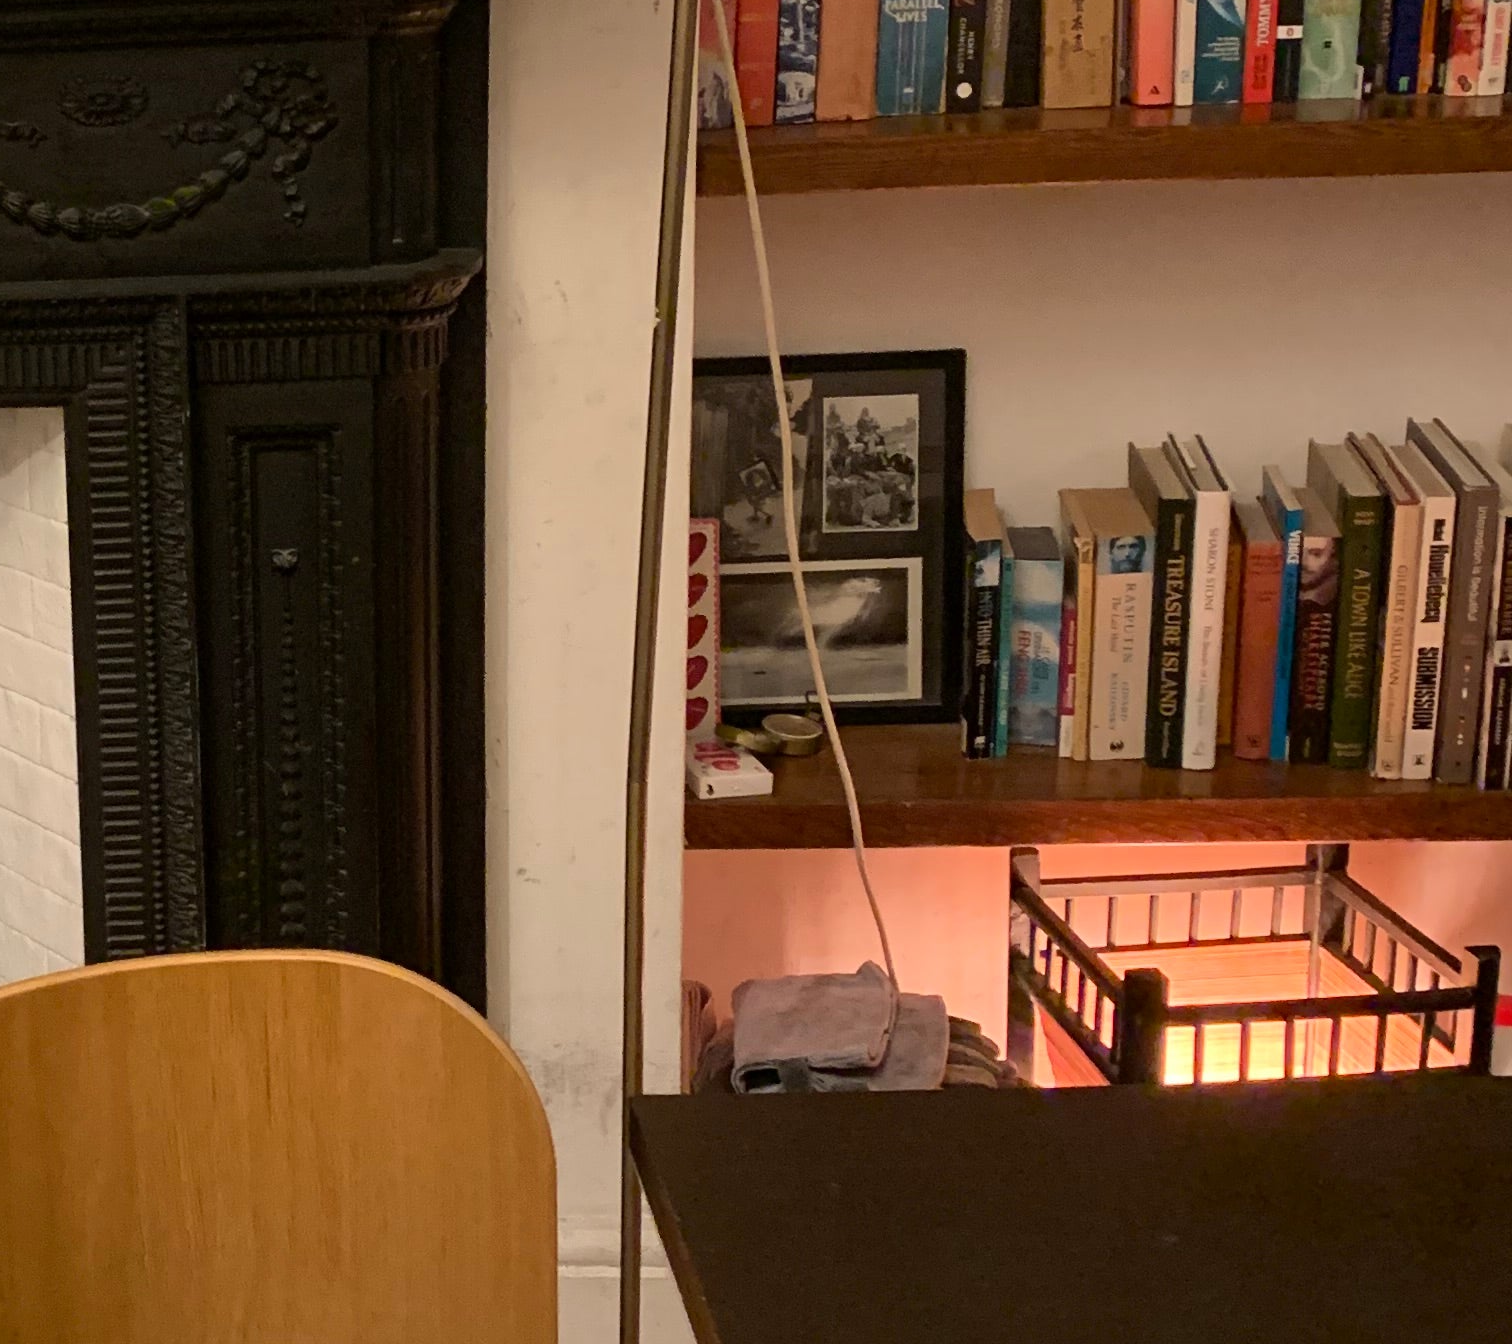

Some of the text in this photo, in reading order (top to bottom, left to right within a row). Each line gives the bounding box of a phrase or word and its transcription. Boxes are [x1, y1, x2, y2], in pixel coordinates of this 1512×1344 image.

[894, 8, 928, 23] LIVES
[957, 17, 968, 75] CHANCELLOR
[1206, 527, 1219, 575] SHARON
[1286, 530, 1302, 565] VENICE
[1474, 506, 1489, 563] Information
[979, 591, 993, 618] INTO
[1163, 555, 1186, 646] TREASURE
[1203, 577, 1216, 611] STONE
[1393, 565, 1409, 612] GILBERT
[1420, 544, 1450, 623] Houellebecq
[1466, 577, 1482, 622] Beautiful
[976, 618, 993, 646] THIN
[1123, 582, 1138, 664] RASPUTIN
[1344, 568, 1371, 699] A TOWN LIKE ALICE
[975, 648, 991, 667] AIR
[1388, 626, 1404, 686] SULLIVAN
[1159, 651, 1179, 716] ISLAND
[1411, 647, 1440, 731] SUBMISSION
